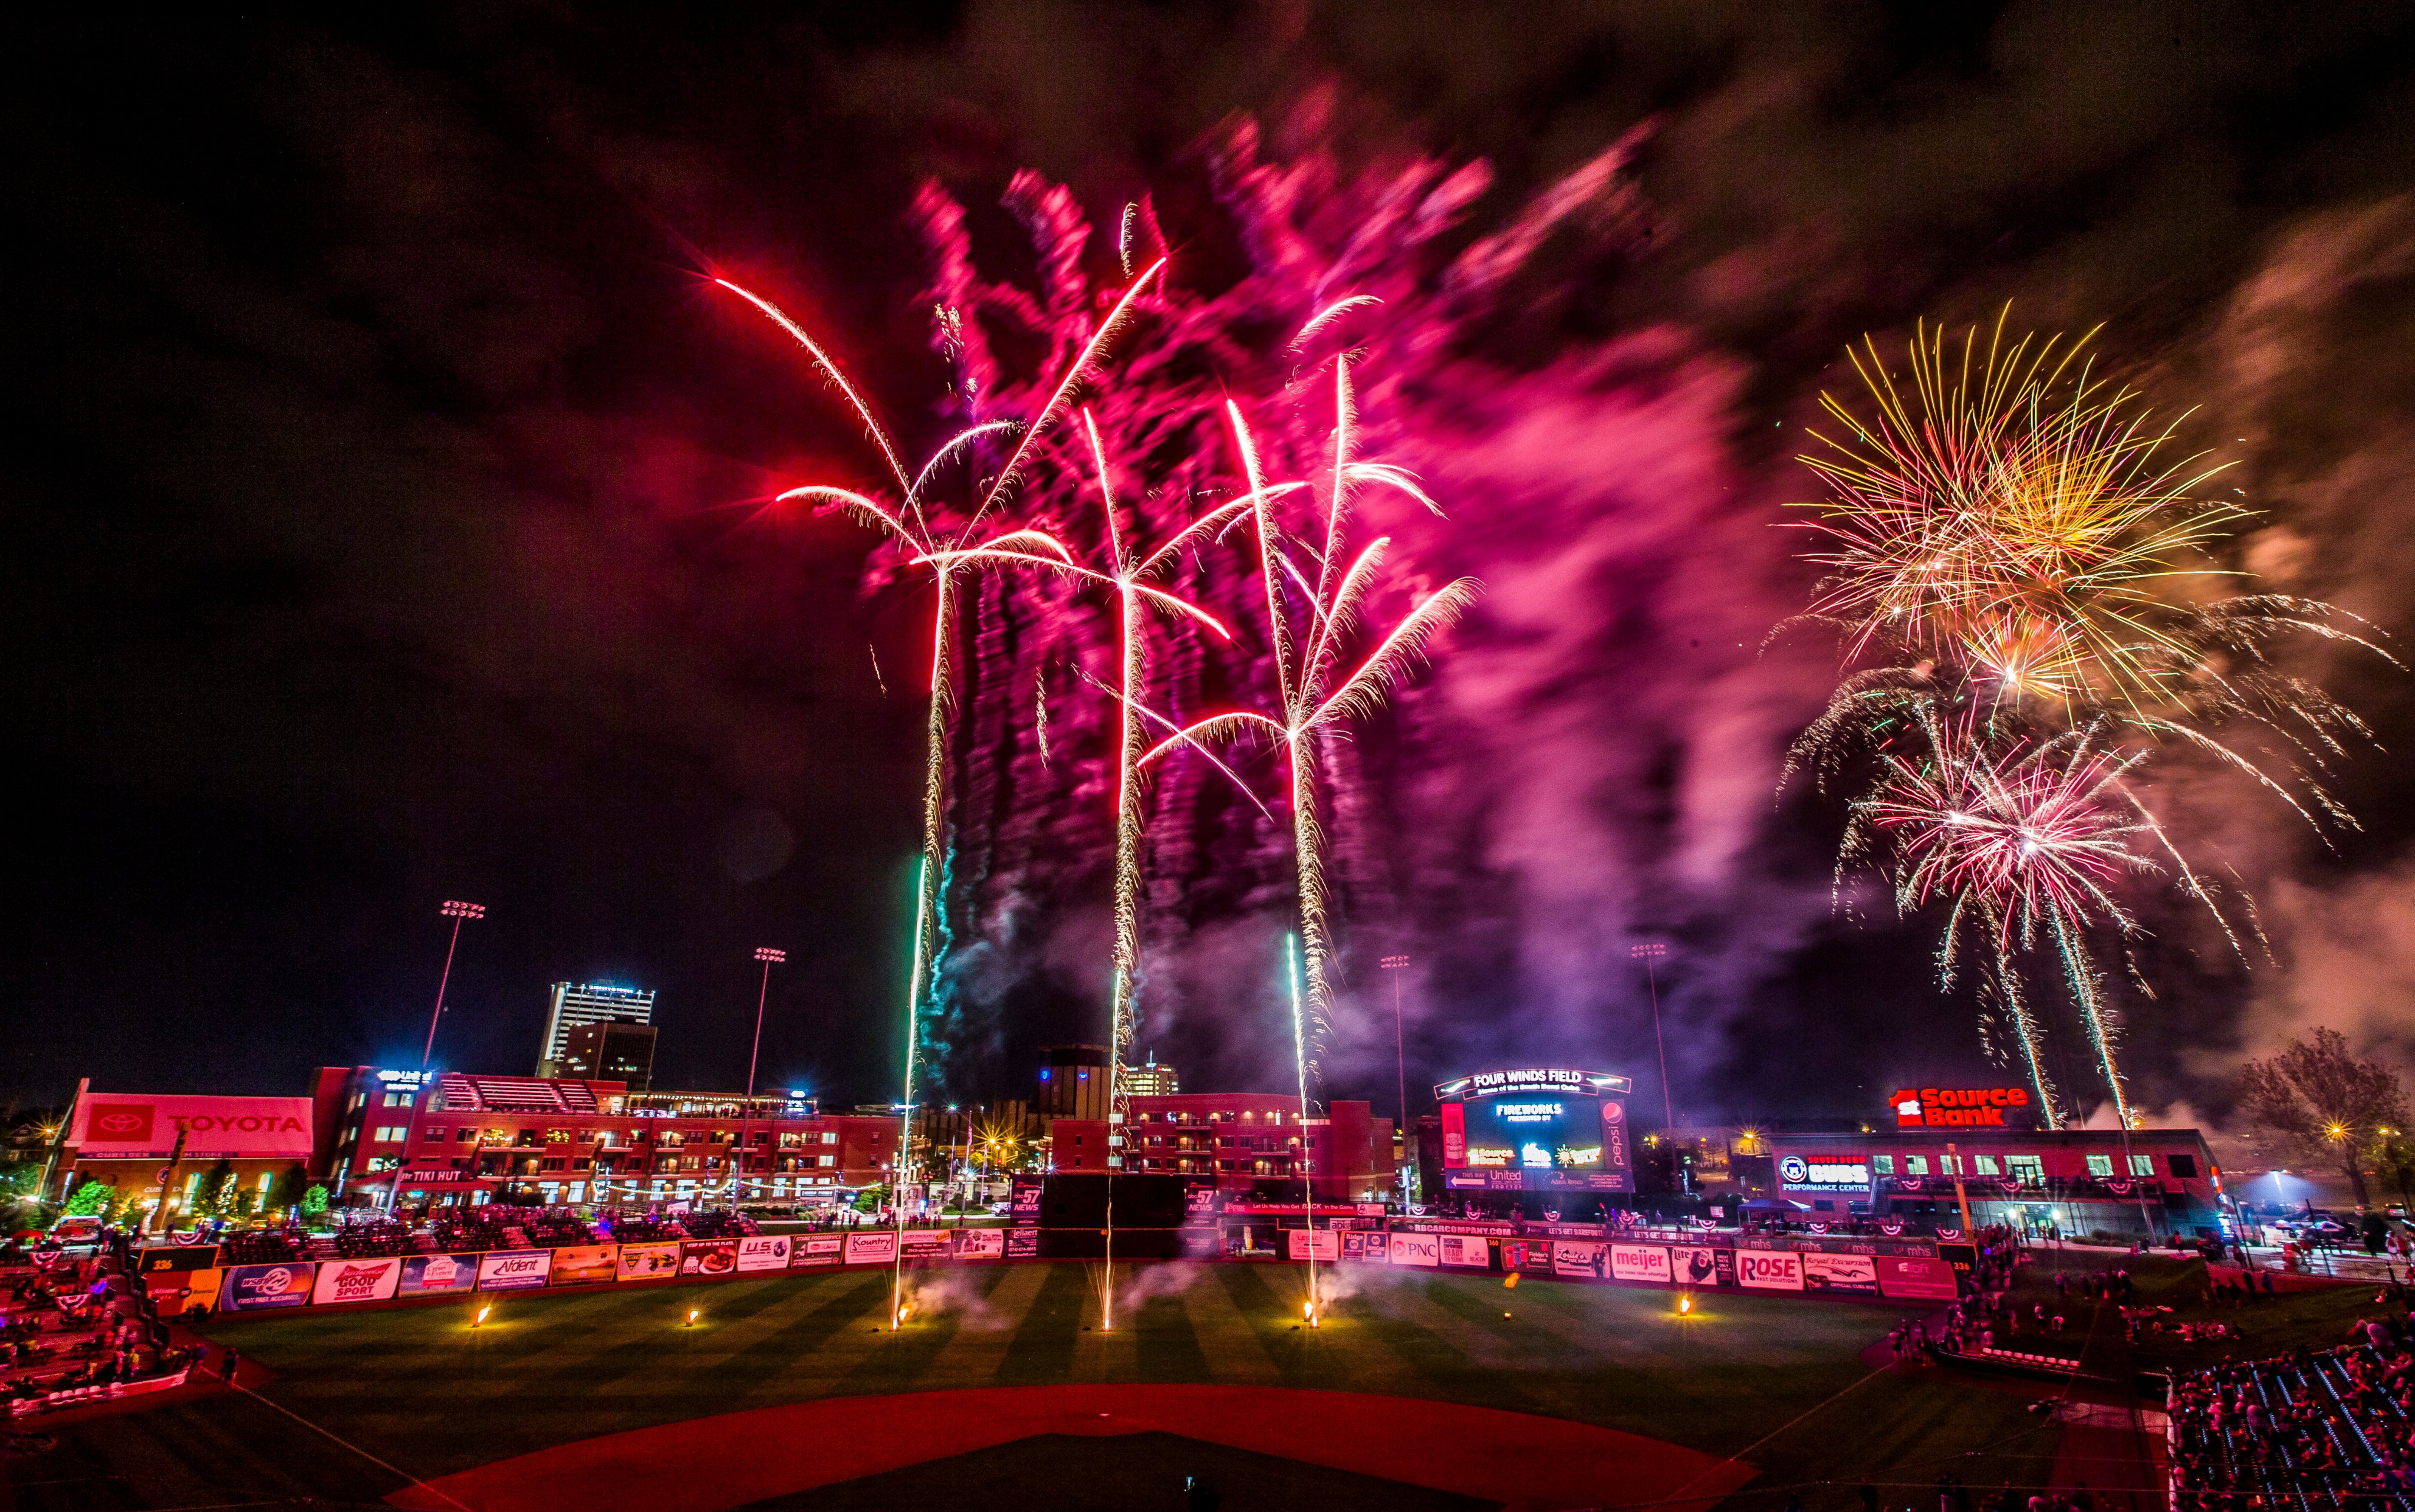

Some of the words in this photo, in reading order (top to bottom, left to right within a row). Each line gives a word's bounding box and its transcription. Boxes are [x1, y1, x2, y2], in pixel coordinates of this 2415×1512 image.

[1474, 1073, 1505, 1088] FOUR
[1506, 1070, 1547, 1083] WINDS
[1548, 1070, 1582, 1083] FIELD
[1478, 1087, 1499, 1095] Home
[1920, 1088, 2028, 1107] Source
[1496, 1103, 1562, 1116] FIREWORKS
[1924, 1105, 2005, 1126] Bank
[166, 1115, 304, 1132] TOYOTA
[1608, 1126, 1624, 1165] pepsi
[1807, 1155, 1838, 1164] SOUTH
[1838, 1155, 1866, 1164] BEND
[413, 1171, 435, 1181] TIKI
[437, 1170, 461, 1181] HUT
[1490, 1170, 1522, 1181] United
[1808, 1164, 1869, 1183] CUBS
[1782, 1183, 1838, 1191] PERFORMANCE
[1022, 1190, 1041, 1204] 57
[1196, 1190, 1213, 1204] 57
[1188, 1204, 1213, 1212] NEWS
[1414, 1224, 1511, 1236] RBCARCOMPANY.COM
[746, 1241, 772, 1252] U.S.
[853, 1236, 891, 1251] Kountry
[1750, 1239, 1772, 1250] mhs
[1800, 1241, 1822, 1251] mhs
[1852, 1243, 1876, 1254] mhs
[1407, 1243, 1436, 1257] PNC
[1444, 1248, 1463, 1256] READY
[1674, 1249, 1690, 1260] Lite
[1907, 1246, 1932, 1257] mhs
[153, 1260, 173, 1270] 336
[1616, 1249, 1664, 1270] meijer
[1830, 1258, 1871, 1266] Excursion
[496, 1259, 538, 1273] Afdent
[1740, 1257, 1797, 1281] ROSE
[1953, 1262, 1970, 1270] 336
[338, 1277, 377, 1287] GOOD
[336, 1286, 374, 1296] SPORT
